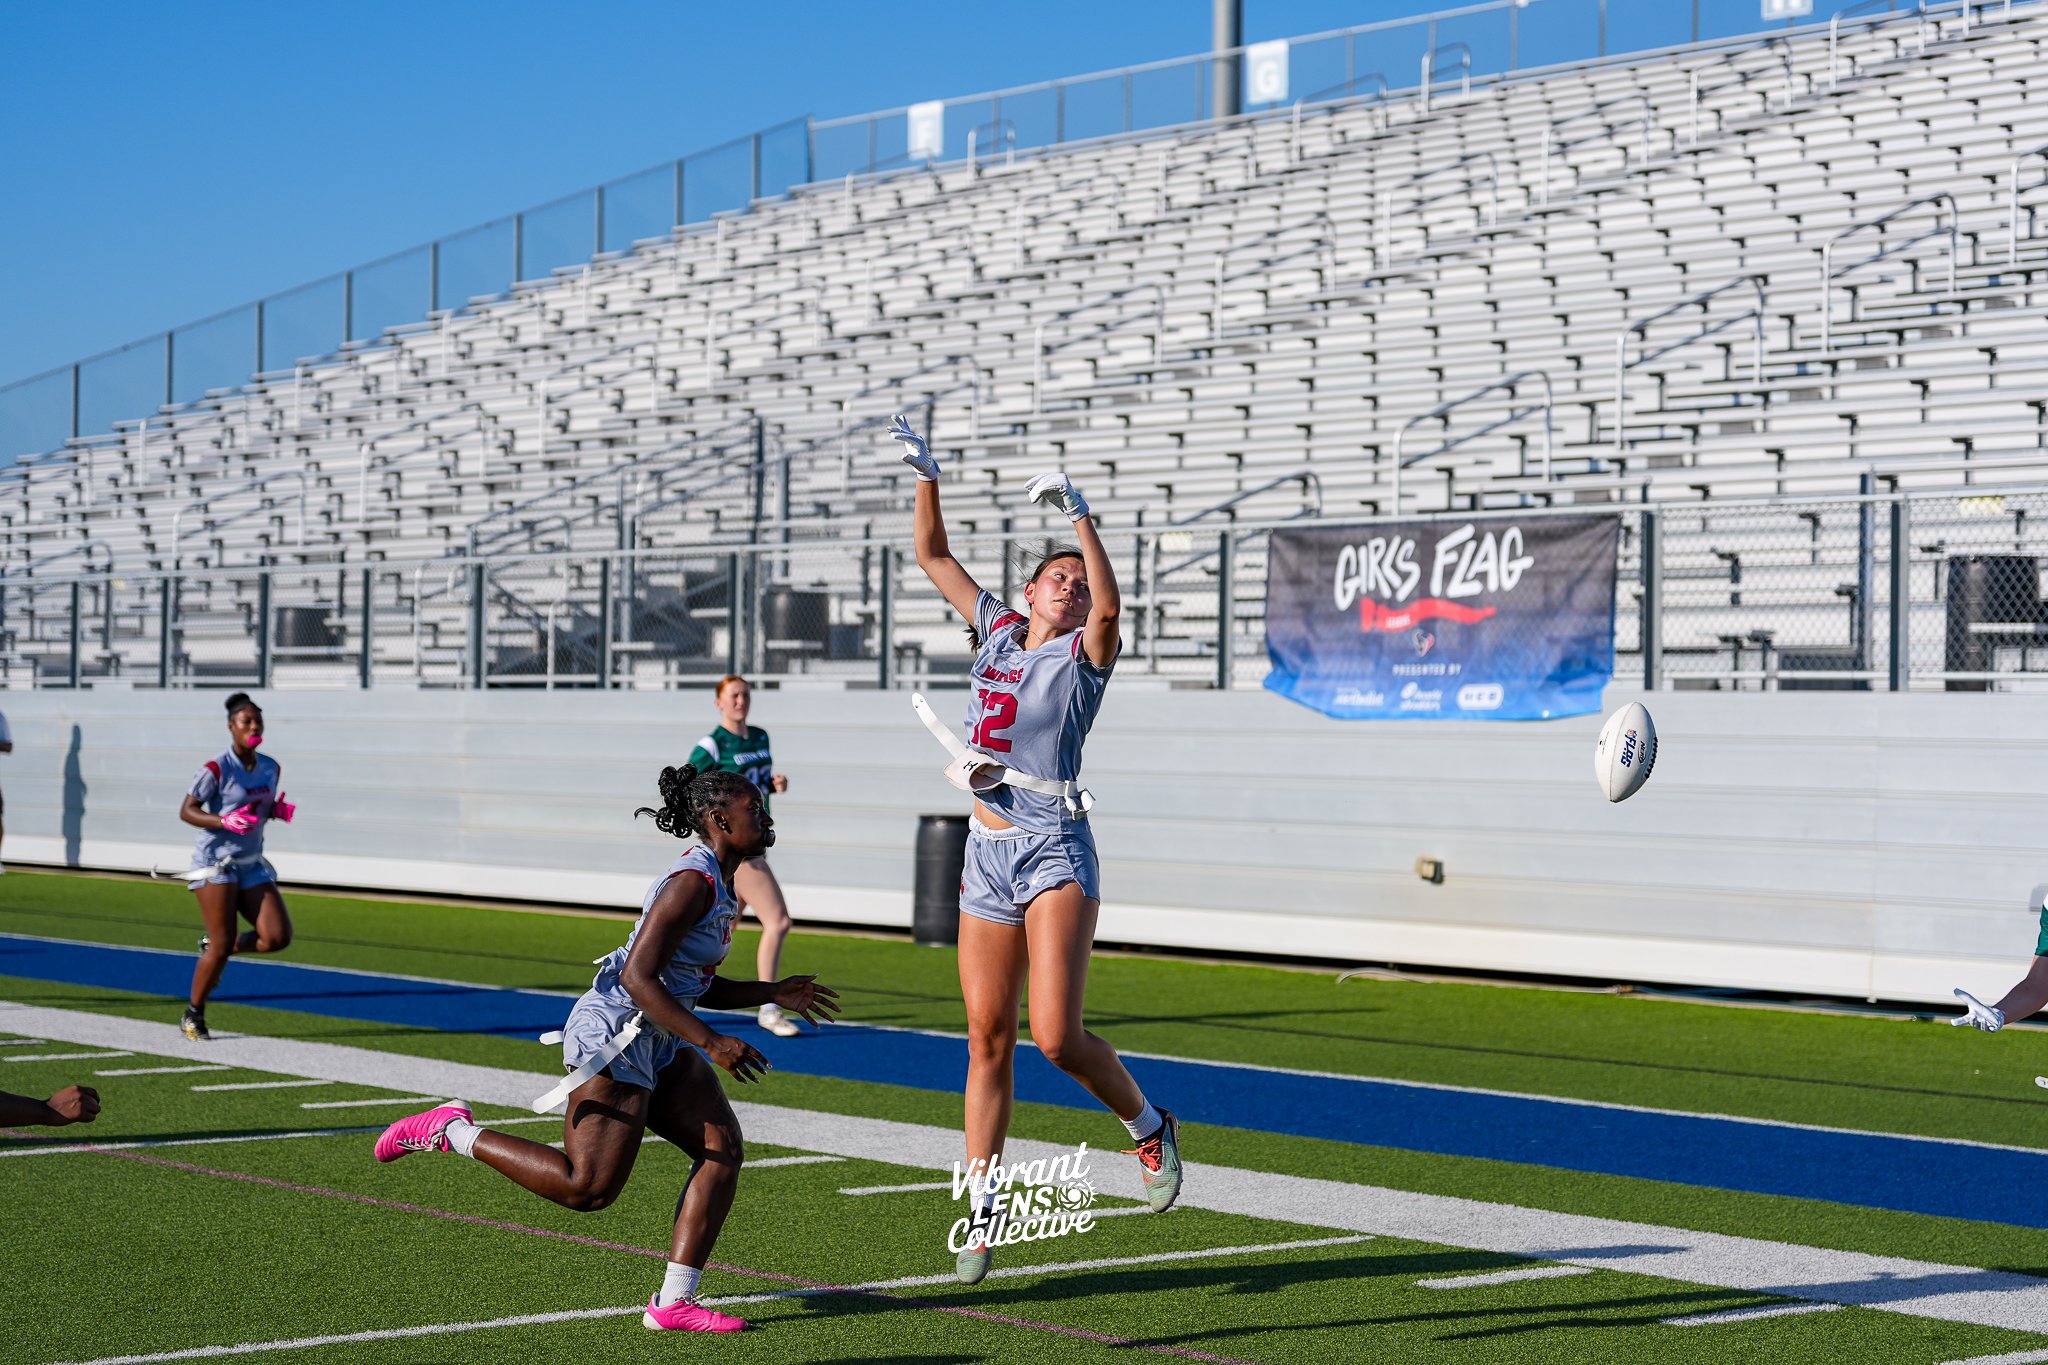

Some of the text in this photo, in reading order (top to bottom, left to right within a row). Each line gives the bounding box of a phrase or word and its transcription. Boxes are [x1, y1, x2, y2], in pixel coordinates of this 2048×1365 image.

[1255, 60, 1281, 94] G
[1334, 524, 1535, 611] GIRLS FLAG
